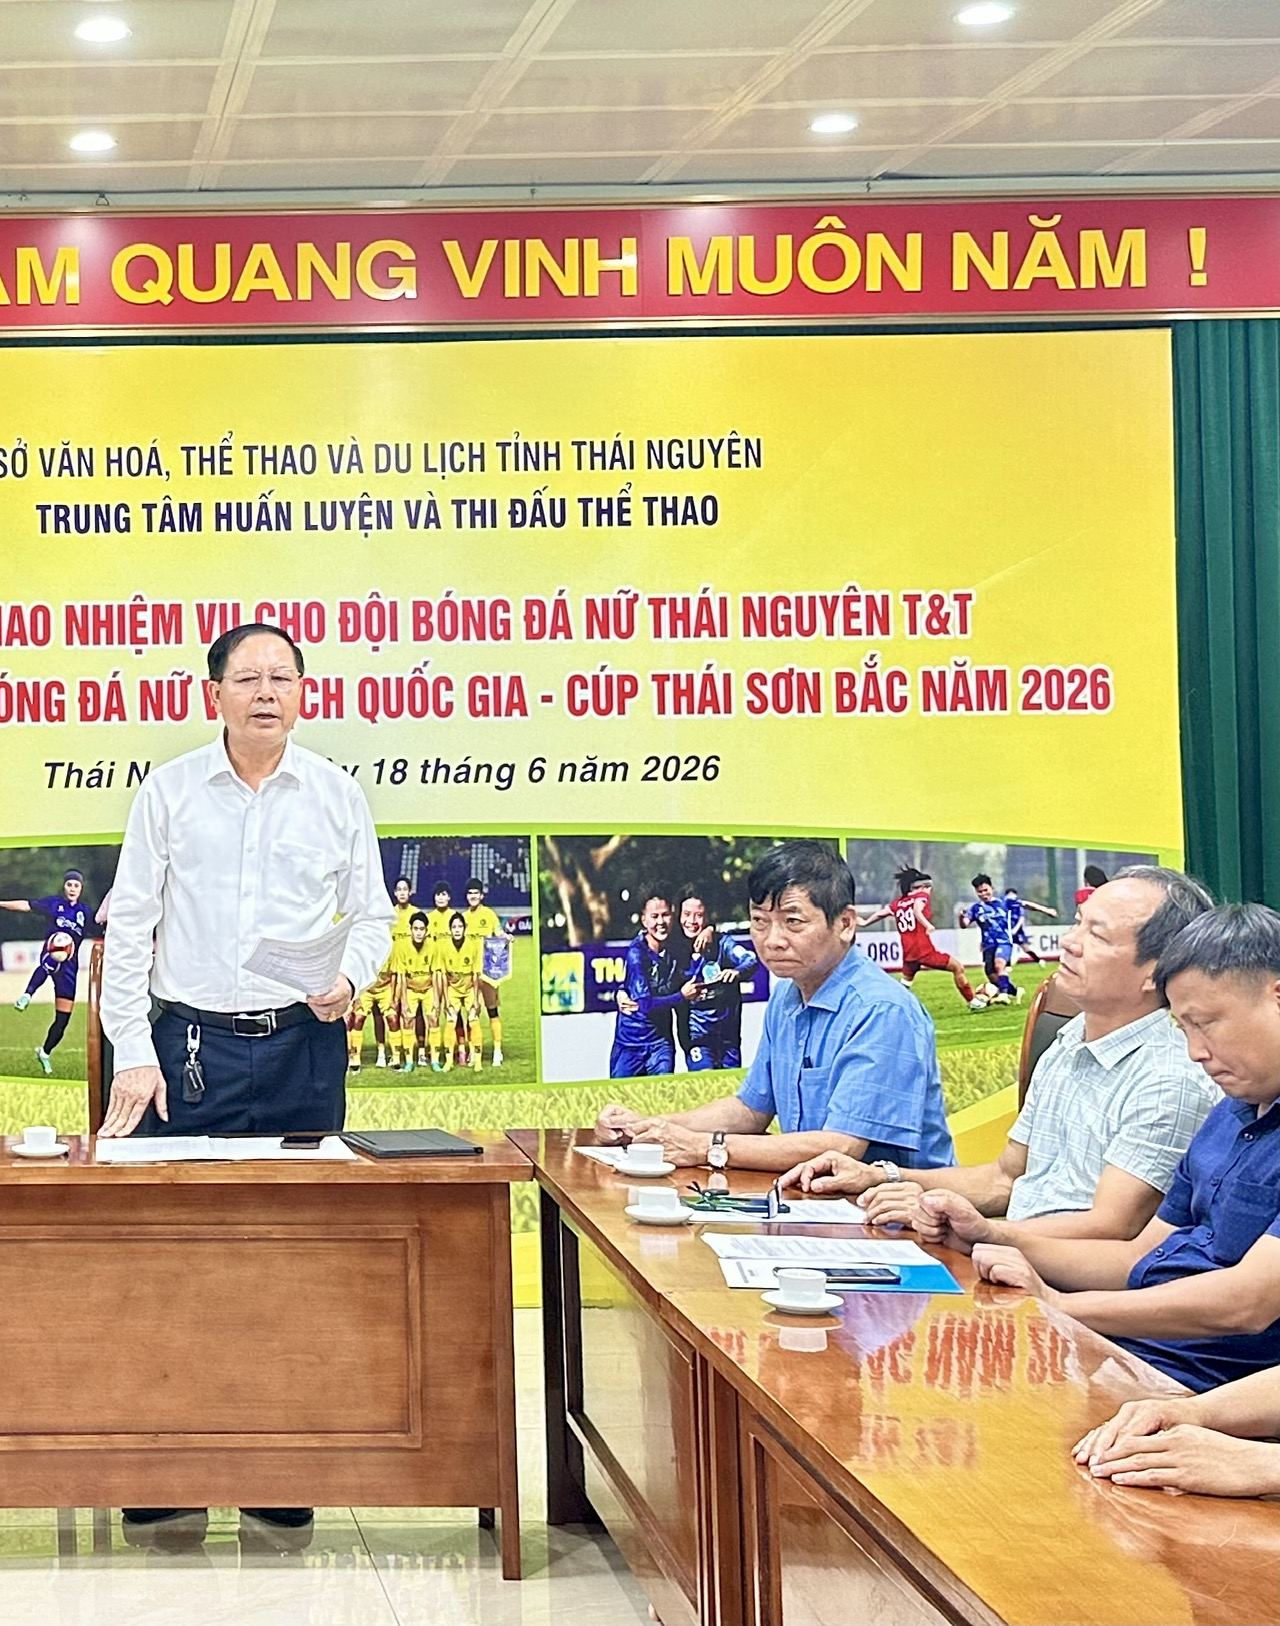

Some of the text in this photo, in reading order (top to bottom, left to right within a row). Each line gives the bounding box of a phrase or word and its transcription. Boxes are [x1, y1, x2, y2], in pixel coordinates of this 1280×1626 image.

[110, 239, 418, 304] QUANG
[442, 237, 638, 299] VINH
[667, 216, 923, 295] MUÔN
[951, 214, 1148, 290] NĂM
[1190, 227, 1208, 286] !
[38, 440, 94, 478] VĂN
[105, 439, 170, 482] HOÁ,
[180, 430, 234, 476] THỂ
[242, 444, 317, 475] THAO
[327, 436, 363, 474] VÀ
[374, 443, 412, 474] DU
[424, 442, 485, 481] LỊCH
[495, 430, 561, 472] TỈNH
[571, 432, 635, 471] THÁI
[646, 429, 762, 470] NGUYÊN
[35, 482, 719, 538] TRUNG TÂM HUẤN LUYỆN VÀ THI ĐẤU THỂ THAO
[64, 595, 183, 655] NHIỆM
[338, 592, 398, 652] ĐỘI
[412, 590, 511, 642] BÓNG
[523, 590, 573, 640] ĐÁ
[585, 590, 639, 640] NỮ
[647, 587, 729, 638] THÁI
[742, 586, 890, 638] NGUYÊN
[902, 592, 973, 636] T&T
[78, 671, 127, 722] ĐÁ
[139, 670, 193, 721] NỮ
[358, 660, 454, 724] QUỐC
[468, 675, 529, 718] GIA
[541, 694, 554, 704] -
[567, 665, 639, 717] CÚP
[651, 664, 732, 716] THÁI
[746, 669, 821, 715] SƠN
[835, 654, 908, 713] BẮC
[922, 660, 1008, 712] NĂM
[1022, 668, 1111, 711] 2026
[44, 760, 116, 789] Thái
[373, 758, 409, 785] 18
[420, 755, 516, 791] tháng
[528, 756, 547, 784] 6
[557, 755, 629, 783] năm
[640, 754, 721, 782] 2026
[896, 907, 916, 932] 39
[690, 1046, 703, 1062] 8
